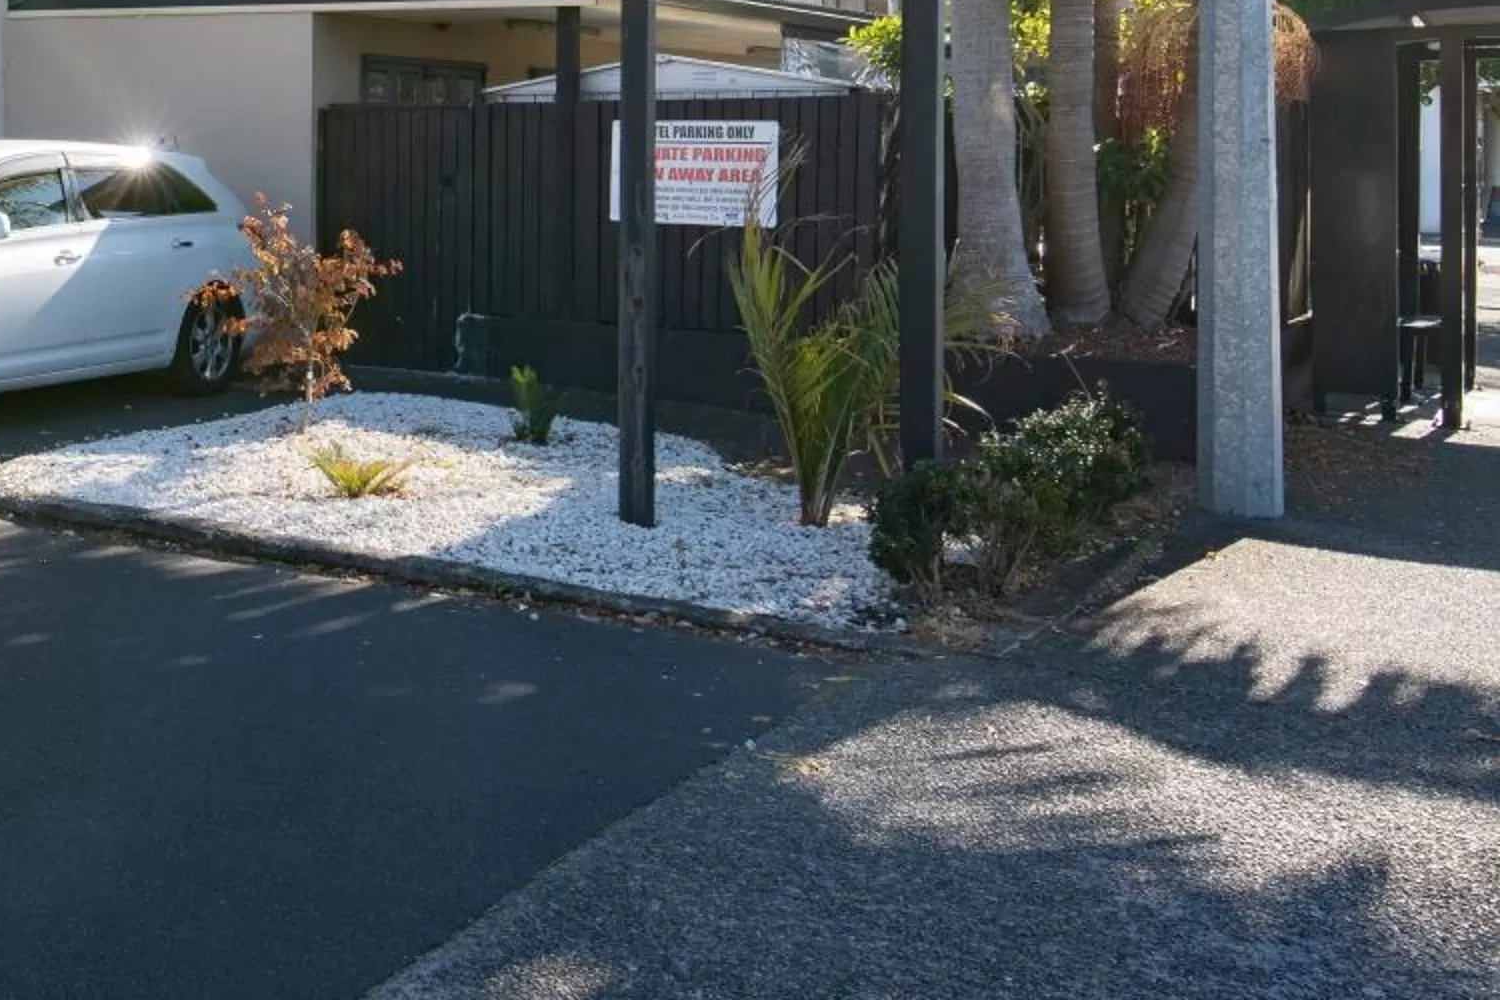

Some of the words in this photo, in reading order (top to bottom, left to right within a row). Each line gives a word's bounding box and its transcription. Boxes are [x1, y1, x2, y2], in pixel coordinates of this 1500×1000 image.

[672, 125, 724, 138] PARKING
[726, 125, 756, 138] ONLY
[693, 147, 766, 162] PARKING
[668, 167, 715, 181] AWAY
